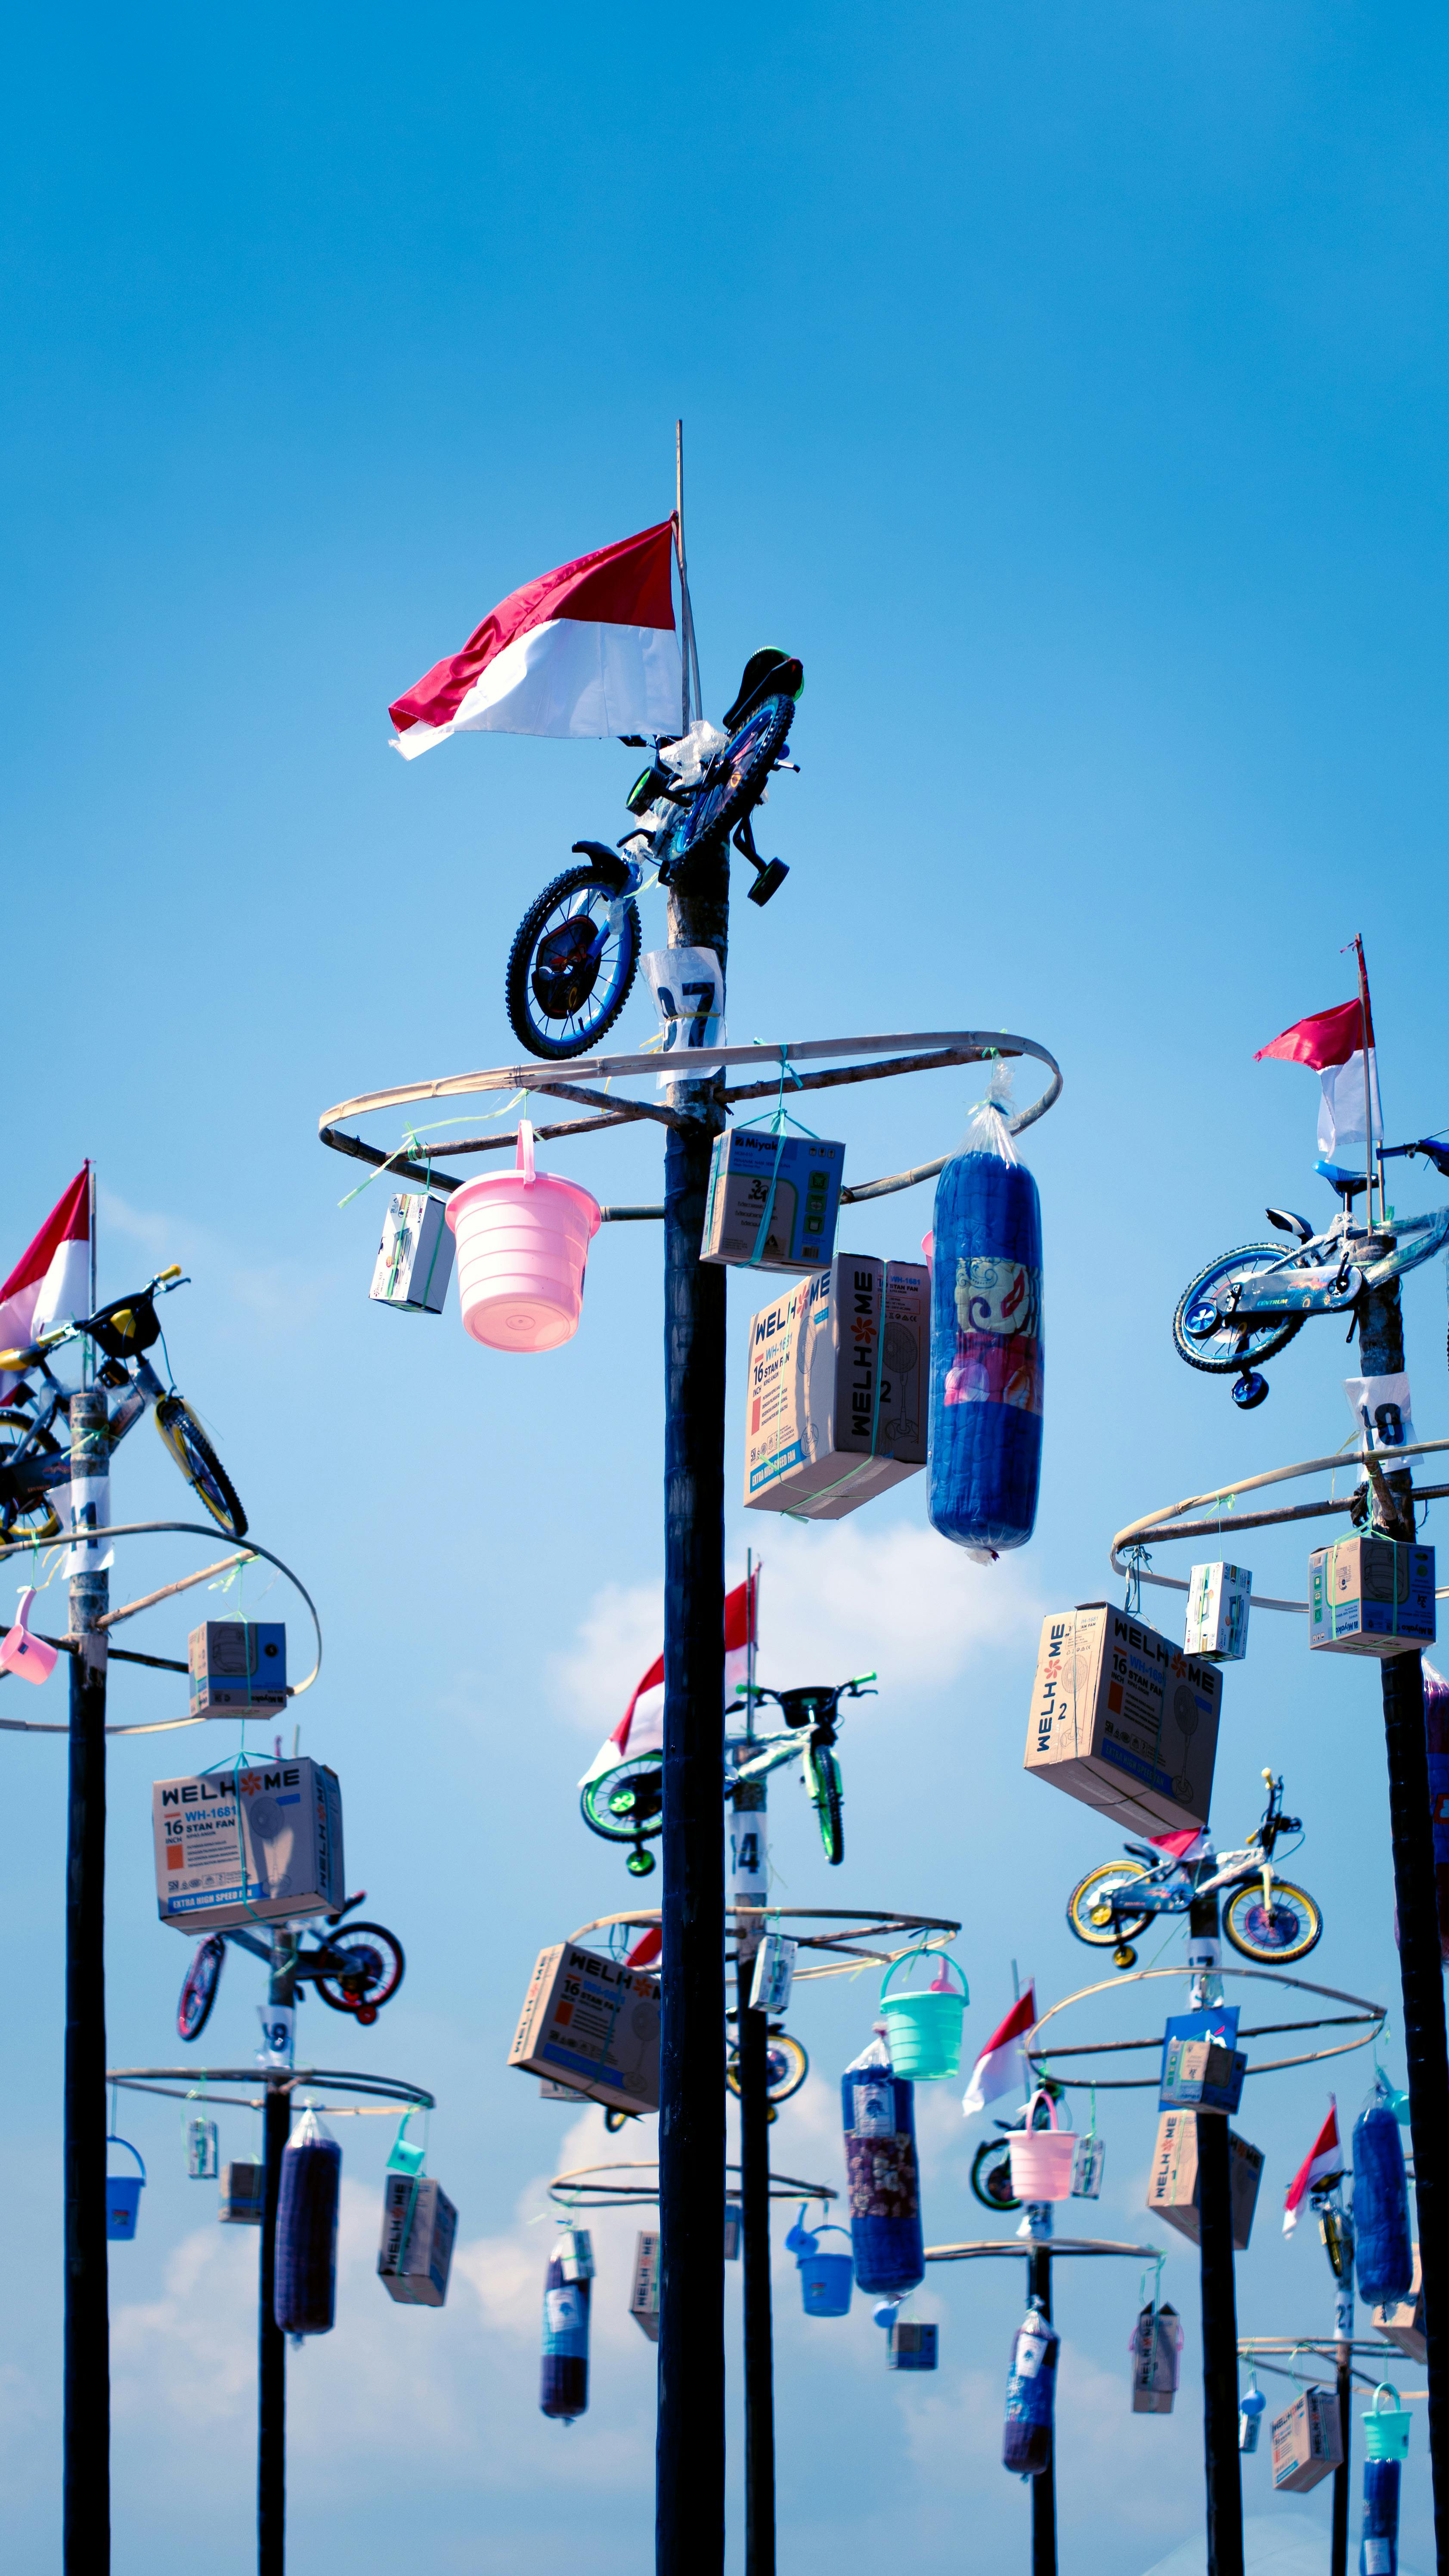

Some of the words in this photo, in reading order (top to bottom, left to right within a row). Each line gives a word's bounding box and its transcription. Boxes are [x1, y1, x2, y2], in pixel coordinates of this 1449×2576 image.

[657, 982, 715, 1052] 07
[745, 1138, 785, 1151] Miyak
[891, 1276, 921, 1285] WH-1681
[754, 1362, 764, 1385] 16
[764, 1360, 778, 1377] STAN
[753, 1385, 762, 1398] INCH
[879, 1380, 892, 1403] 2
[1360, 1403, 1404, 1451] 10
[752, 1469, 764, 1487] EXTRA
[787, 1449, 796, 1463] FAN
[1401, 1624, 1426, 1635] Miyako
[1111, 1671, 1124, 1684] INCH
[1113, 1654, 1127, 1675] 16
[1128, 1670, 1148, 1688] STAN
[1149, 1681, 1163, 1698] FAN
[1058, 1702, 1067, 1720] 2
[185, 1805, 237, 1822] WH-1681
[164, 1820, 183, 1836] 16
[186, 1822, 213, 1833] STAN
[216, 1819, 235, 1828] FAN
[173, 1897, 195, 1909] EXTRA
[196, 1895, 214, 1905] HIGH
[216, 1891, 238, 1902] SPEED
[239, 1889, 252, 1898] FN
[564, 1979, 579, 1996] 16
